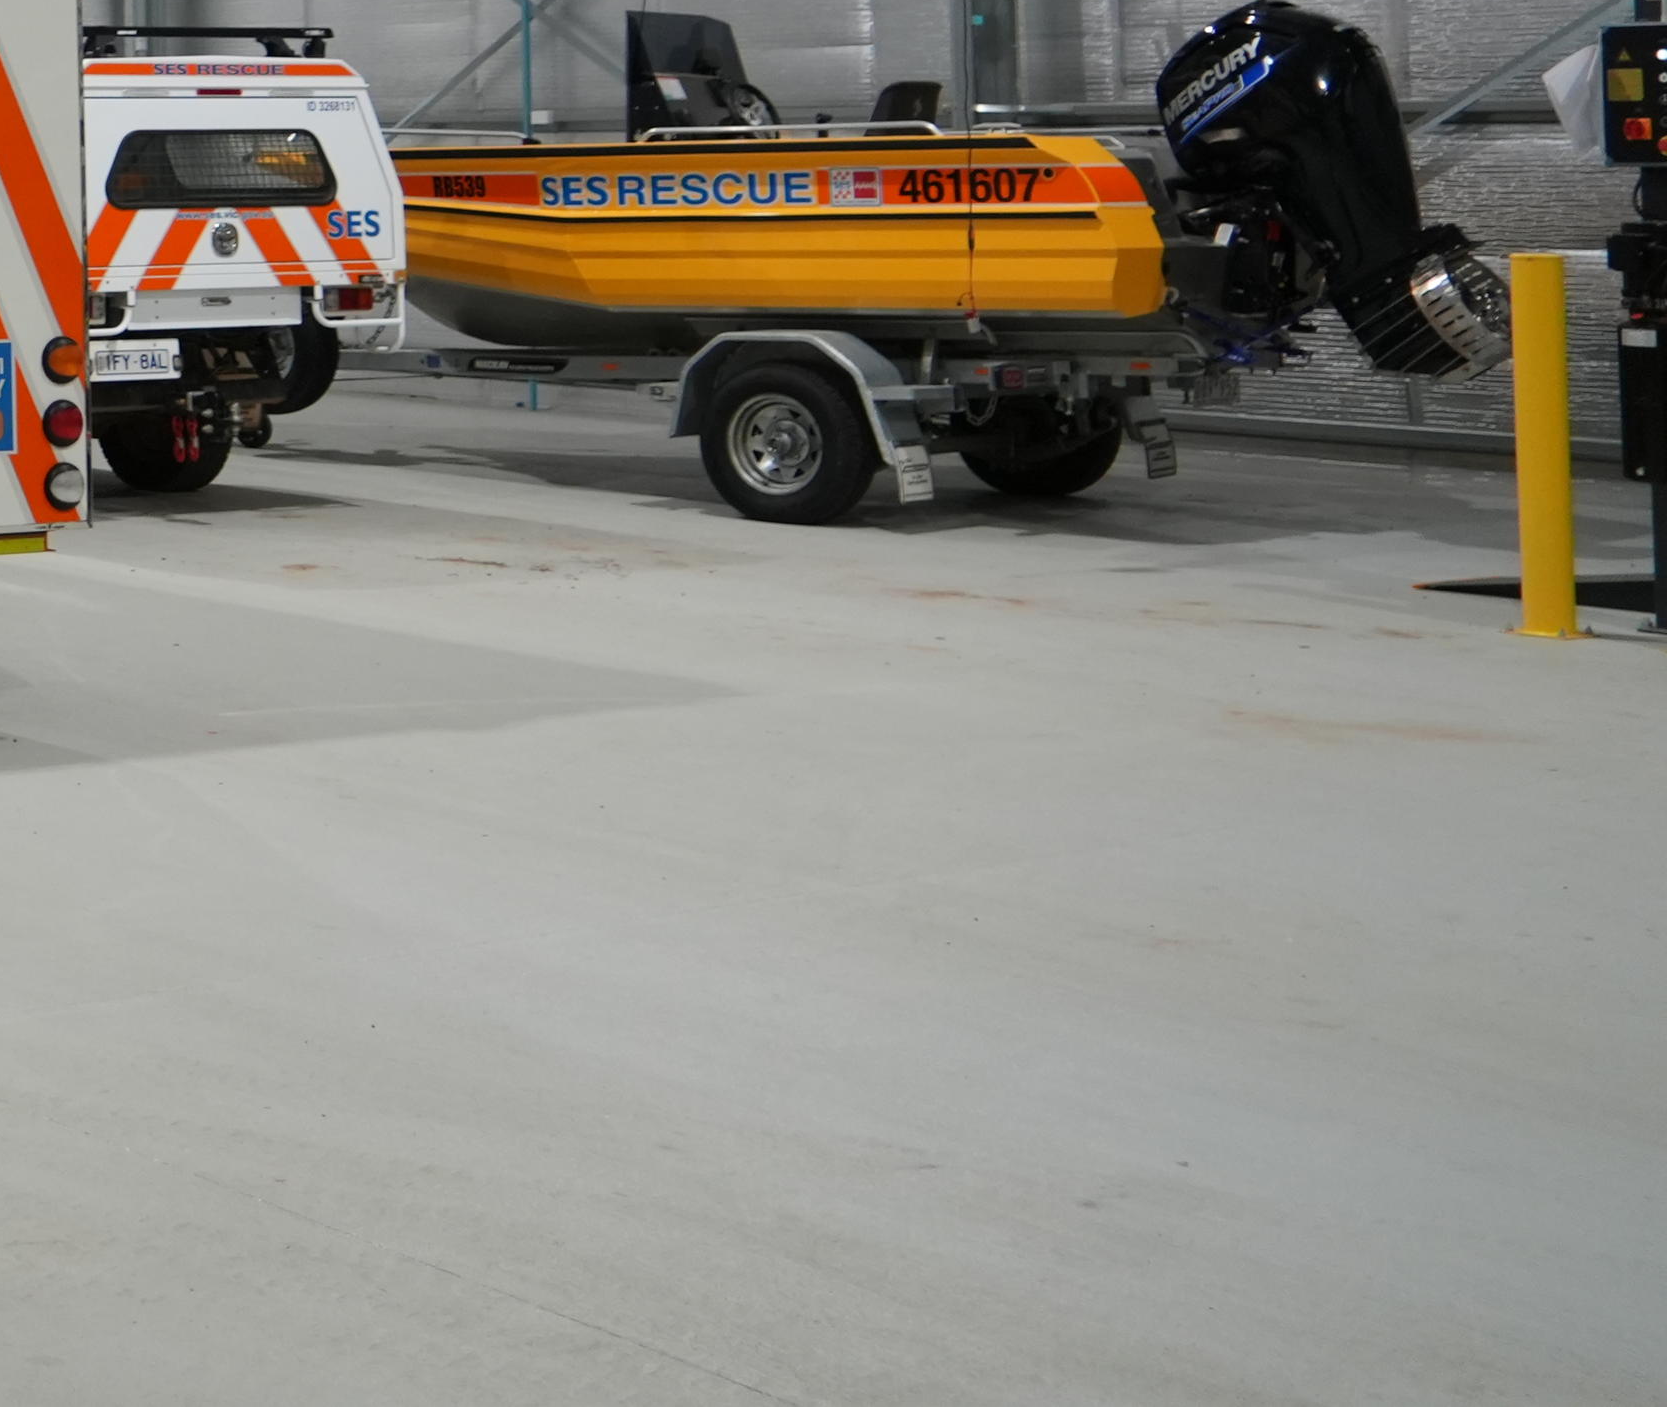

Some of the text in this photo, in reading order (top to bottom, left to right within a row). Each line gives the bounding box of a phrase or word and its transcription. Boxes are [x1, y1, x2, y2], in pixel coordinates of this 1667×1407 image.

[154, 64, 284, 75] SES RESCUE
[1163, 31, 1262, 126] MERCURY
[432, 176, 486, 198] RB539
[541, 172, 812, 206] SES RESCUE
[899, 169, 1040, 203] 461607
[327, 210, 380, 238] SES
